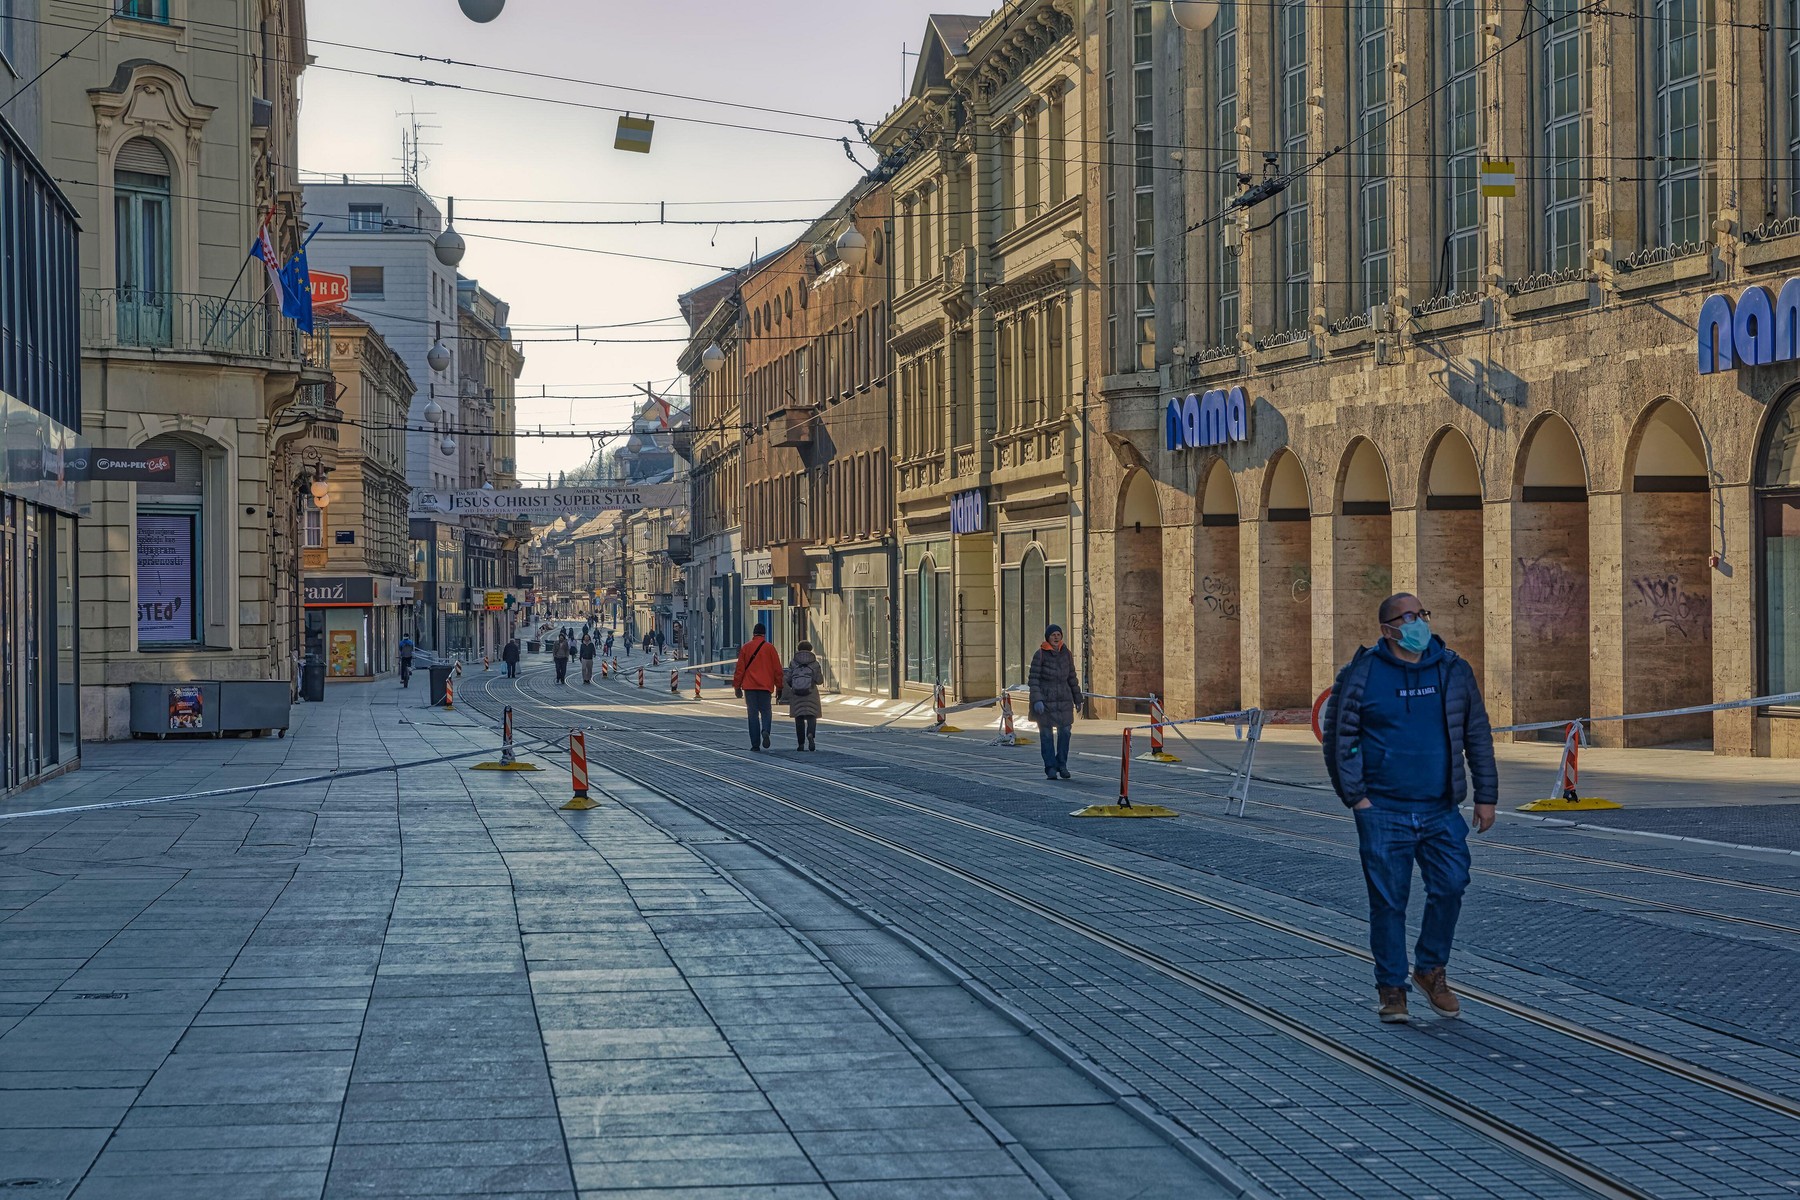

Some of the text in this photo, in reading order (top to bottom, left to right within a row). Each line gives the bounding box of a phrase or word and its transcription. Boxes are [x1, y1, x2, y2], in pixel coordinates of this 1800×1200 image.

[1166, 385, 1248, 451] nama
[109, 461, 147, 469] PAN-PEK
[449, 493, 642, 511] JESUS CHRIST SUPER STAR
[951, 489, 982, 534] nama
